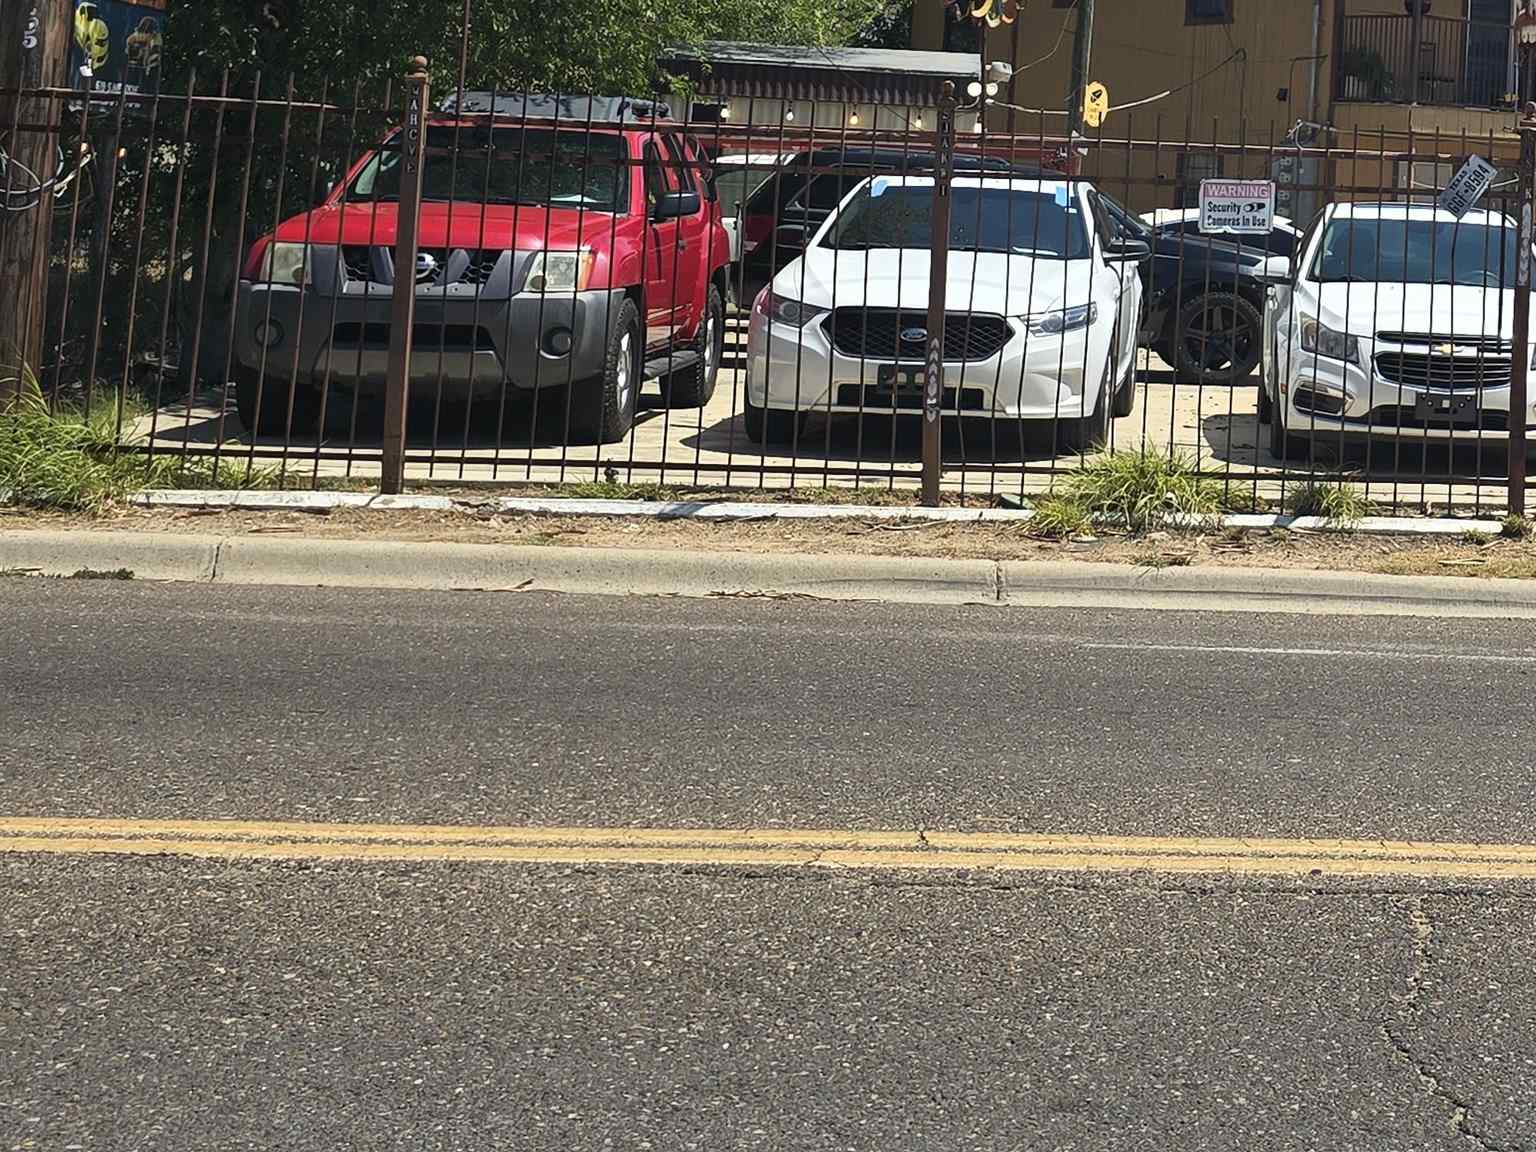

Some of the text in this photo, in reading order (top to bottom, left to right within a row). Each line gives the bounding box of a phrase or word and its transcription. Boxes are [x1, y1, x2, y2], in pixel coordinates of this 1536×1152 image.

[1450, 170, 1467, 191] TEXAS
[1207, 184, 1268, 198] WARNING
[1208, 201, 1241, 215] Security
[1207, 215, 1240, 226] Cameras
[1252, 215, 1266, 227] Use
